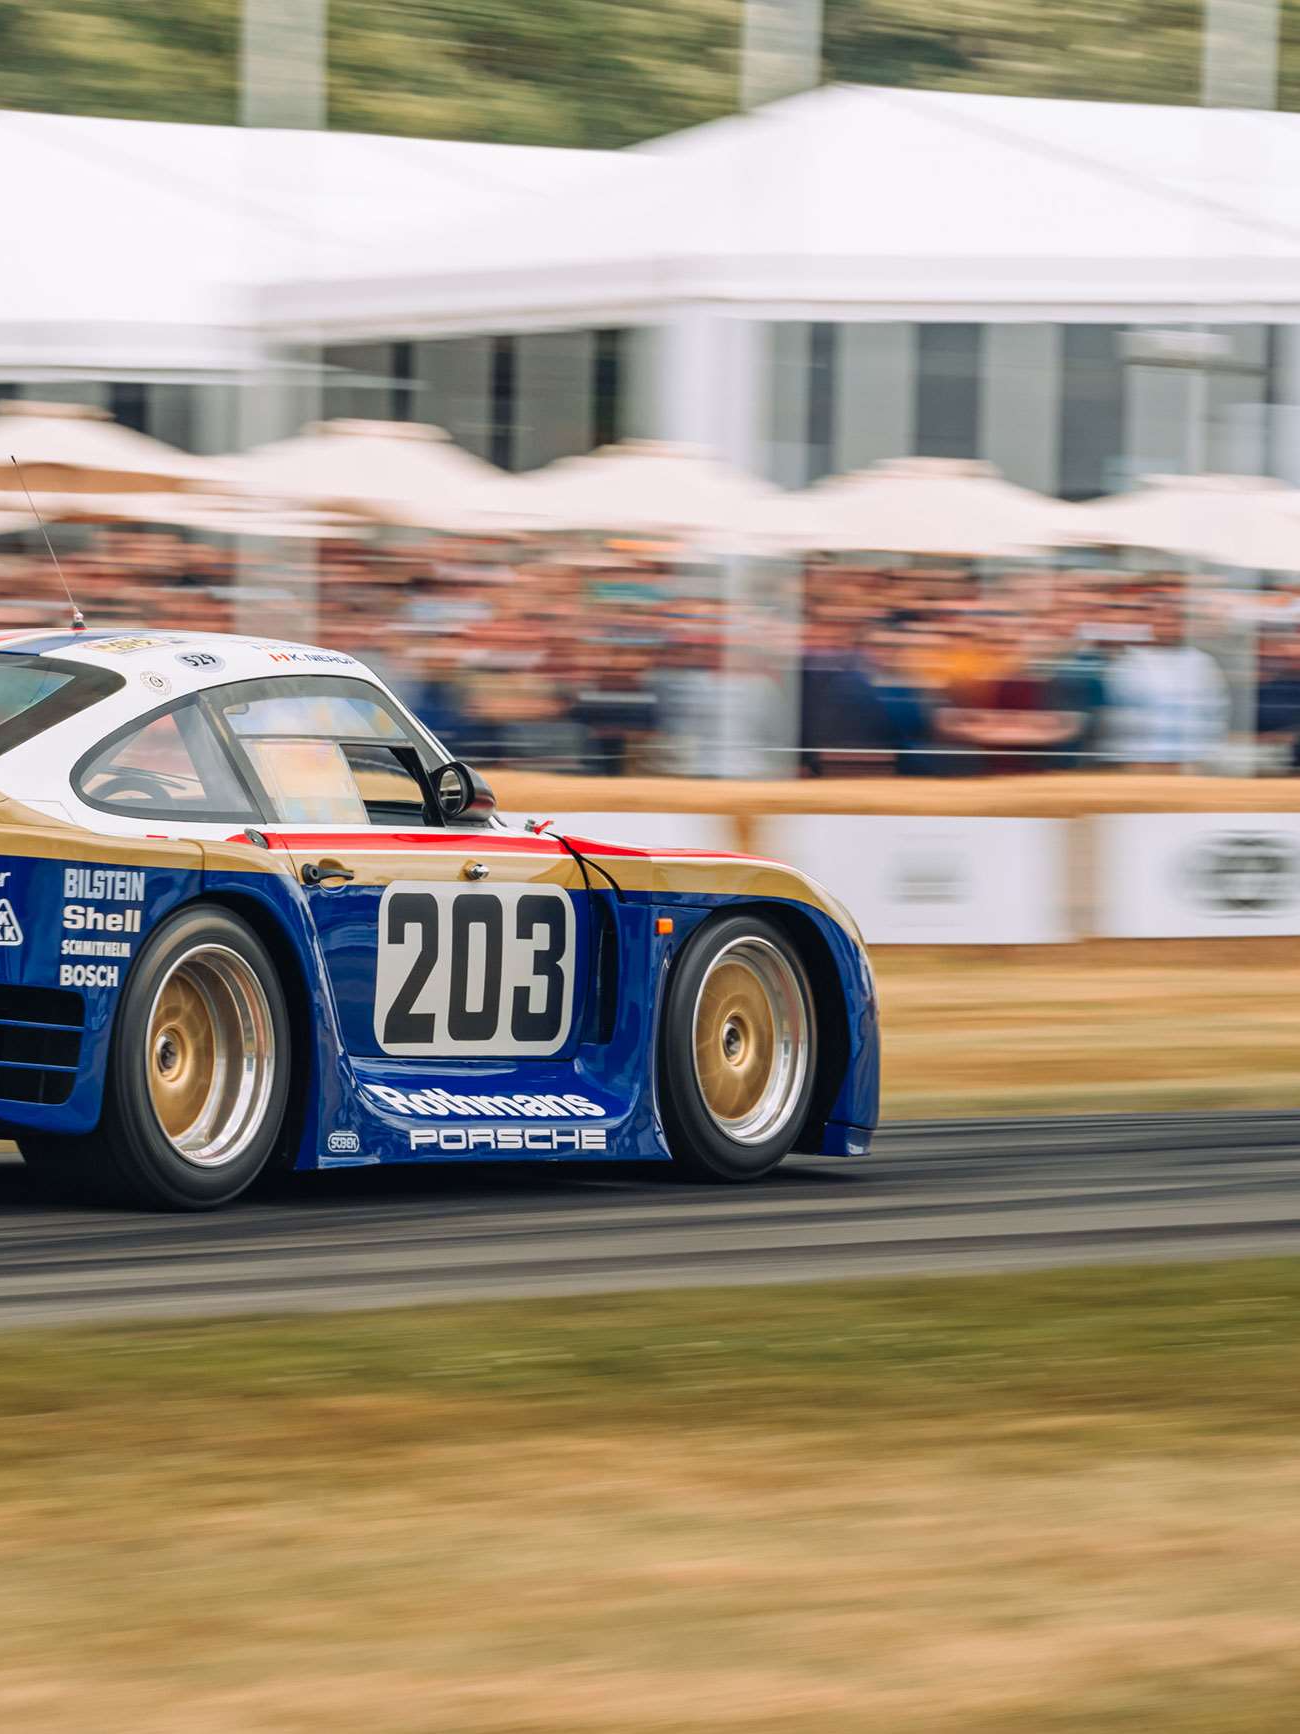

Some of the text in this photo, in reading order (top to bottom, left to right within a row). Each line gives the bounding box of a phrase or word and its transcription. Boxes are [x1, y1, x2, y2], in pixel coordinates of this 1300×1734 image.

[181, 653, 217, 667] 529
[63, 868, 145, 901] BILSTEIN
[63, 905, 141, 933] Shell
[59, 964, 119, 987] BOSCH
[383, 892, 567, 1044] 203
[363, 1084, 606, 1118] Rothmans
[410, 1129, 607, 1151] PORSCHE
